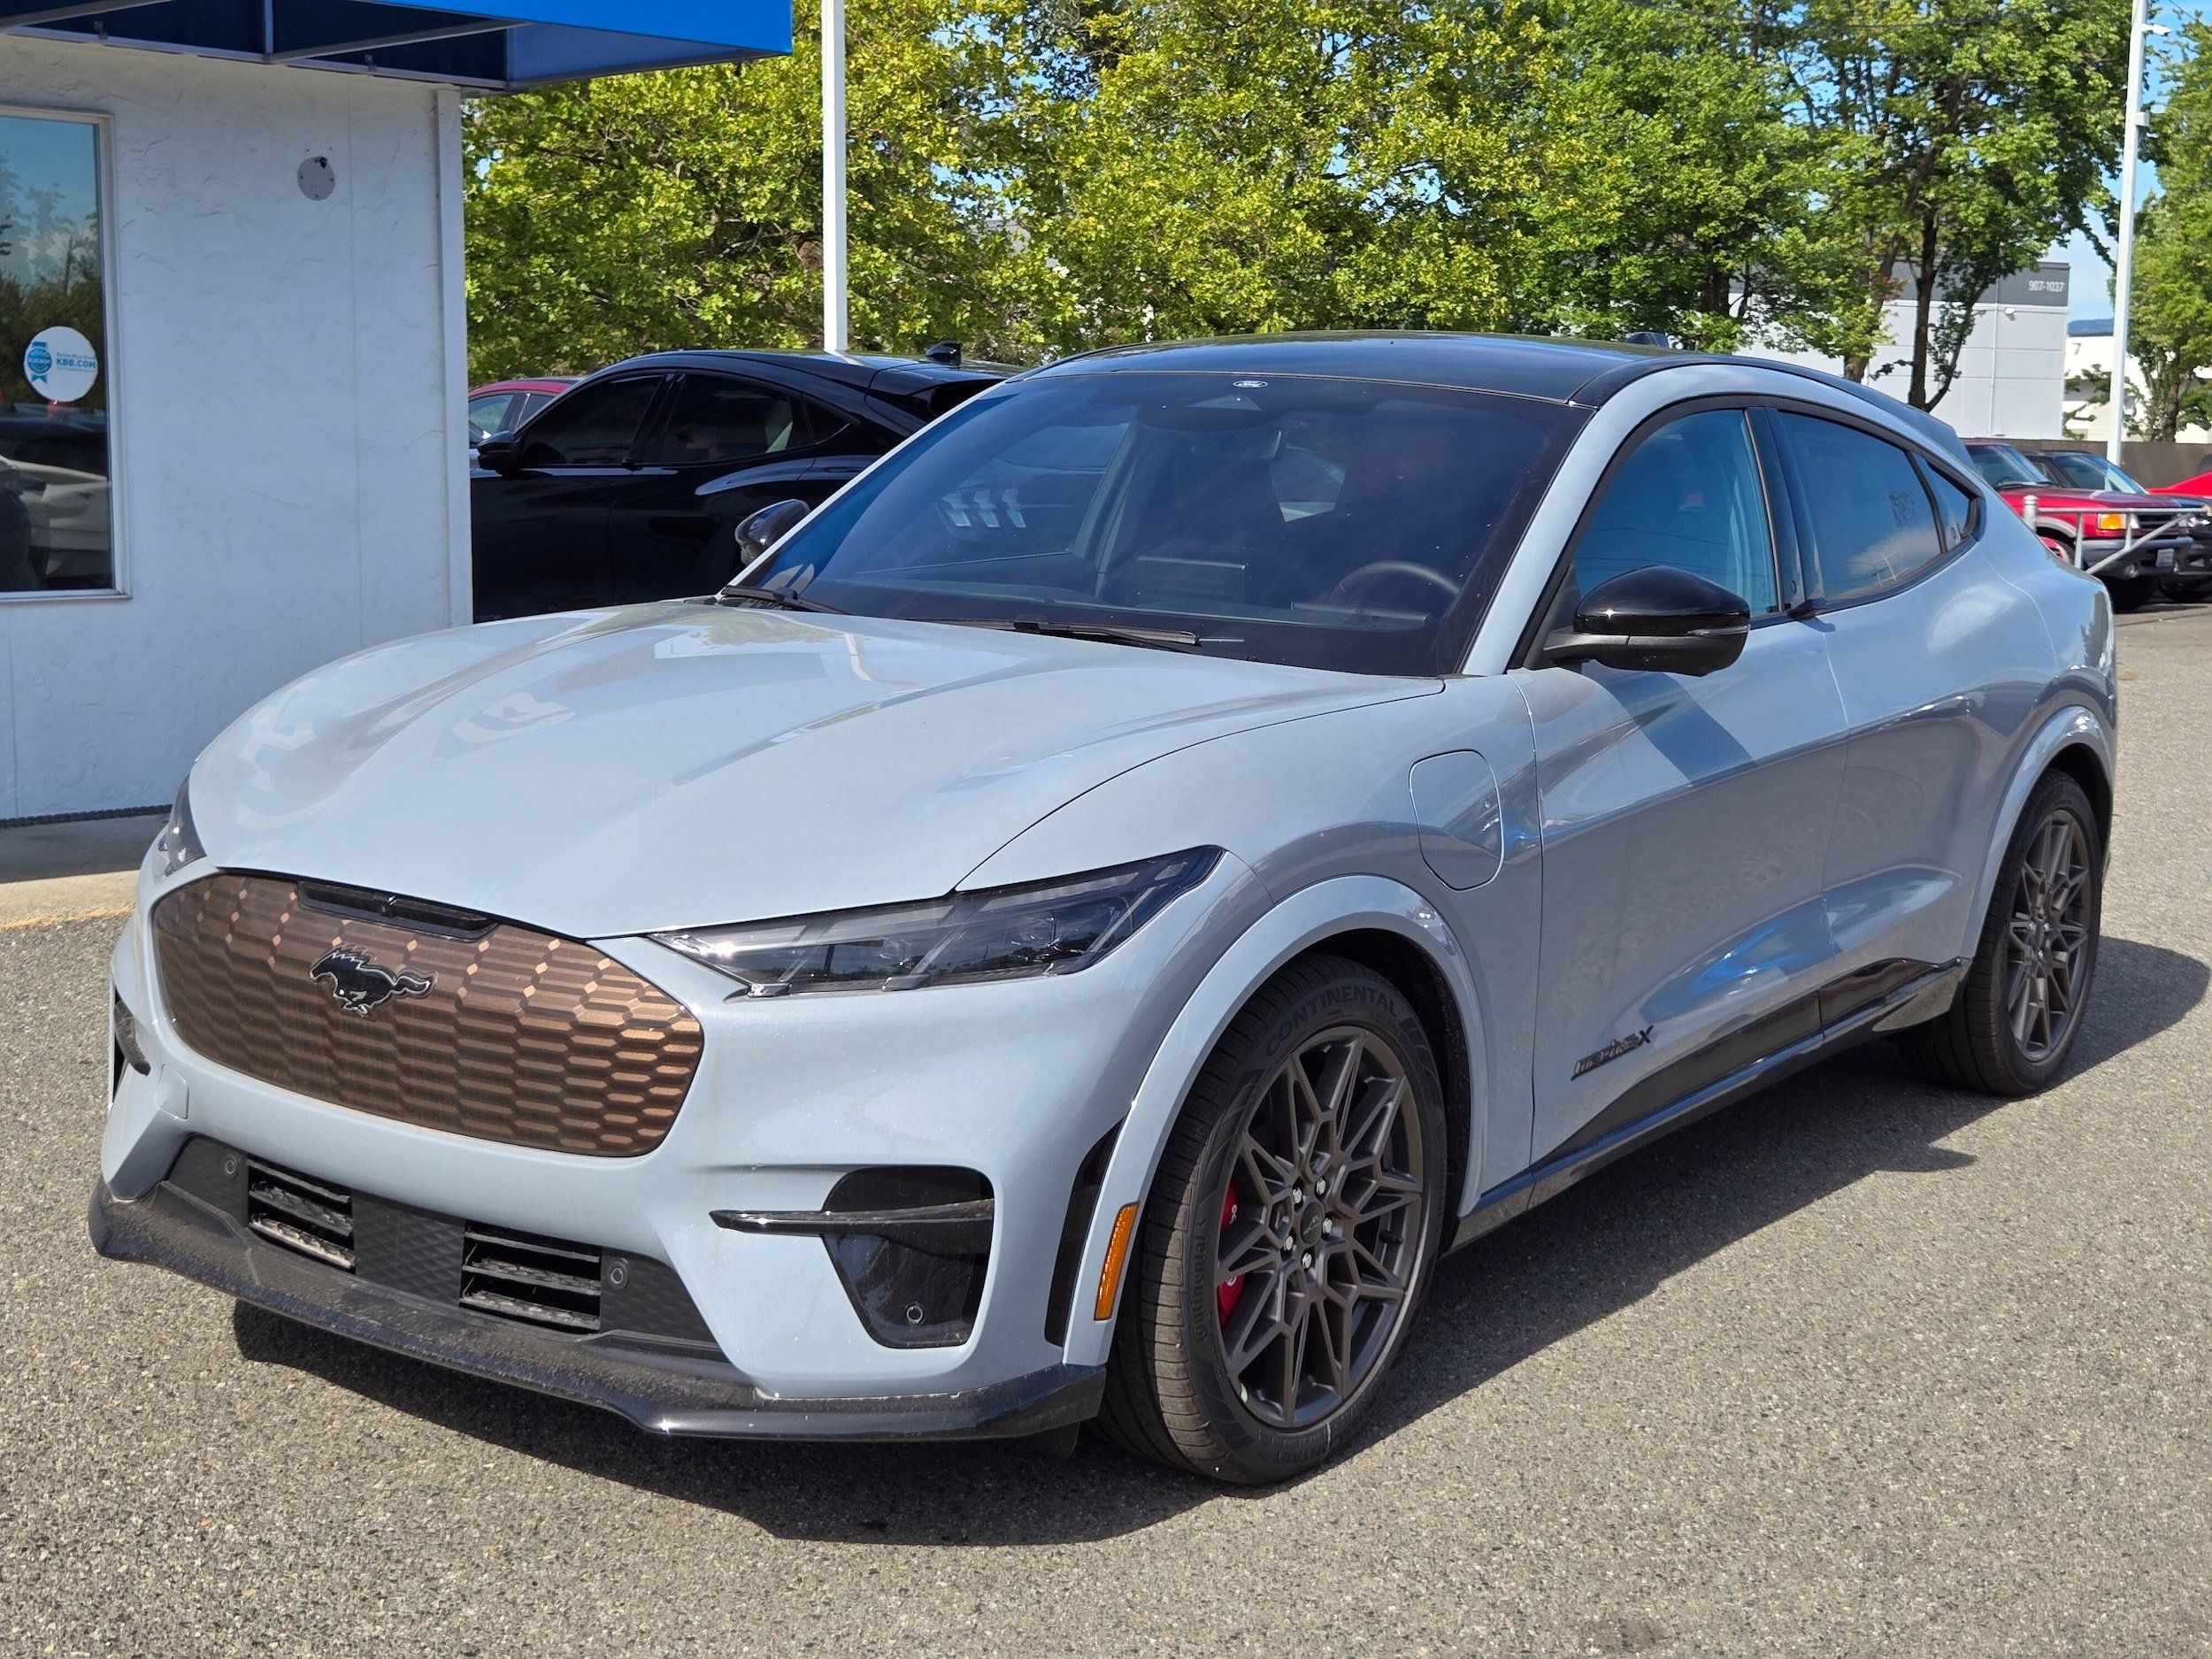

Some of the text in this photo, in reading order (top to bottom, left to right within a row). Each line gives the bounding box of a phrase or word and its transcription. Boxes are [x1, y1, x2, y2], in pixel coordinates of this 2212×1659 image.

[2029, 280, 2064, 292] 907-1037
[56, 357, 96, 368] KBB.COM
[1265, 985, 1398, 1057] CONTINENTAL
